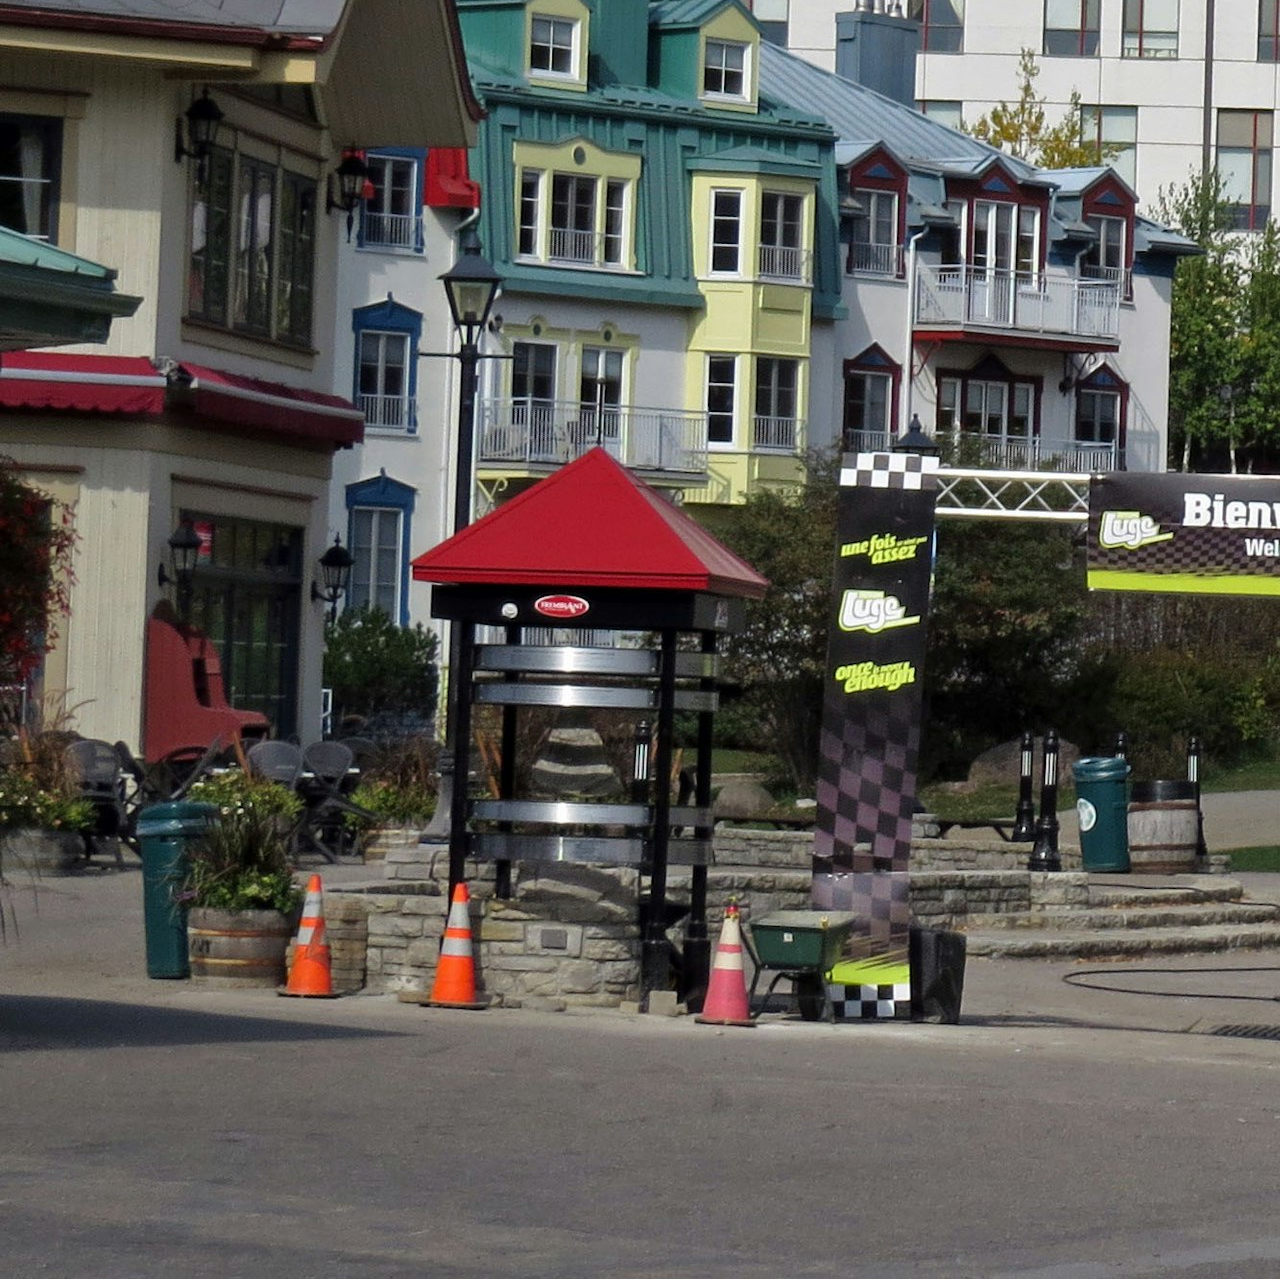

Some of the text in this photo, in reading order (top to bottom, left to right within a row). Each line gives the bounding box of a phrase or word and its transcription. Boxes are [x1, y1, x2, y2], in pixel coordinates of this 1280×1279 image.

[1101, 510, 1161, 548] Luge
[841, 540, 868, 557] une
[868, 533, 897, 556] fois
[871, 544, 917, 565] assez
[841, 589, 907, 630] Luge
[835, 661, 874, 681] once
[844, 661, 916, 693] enough
